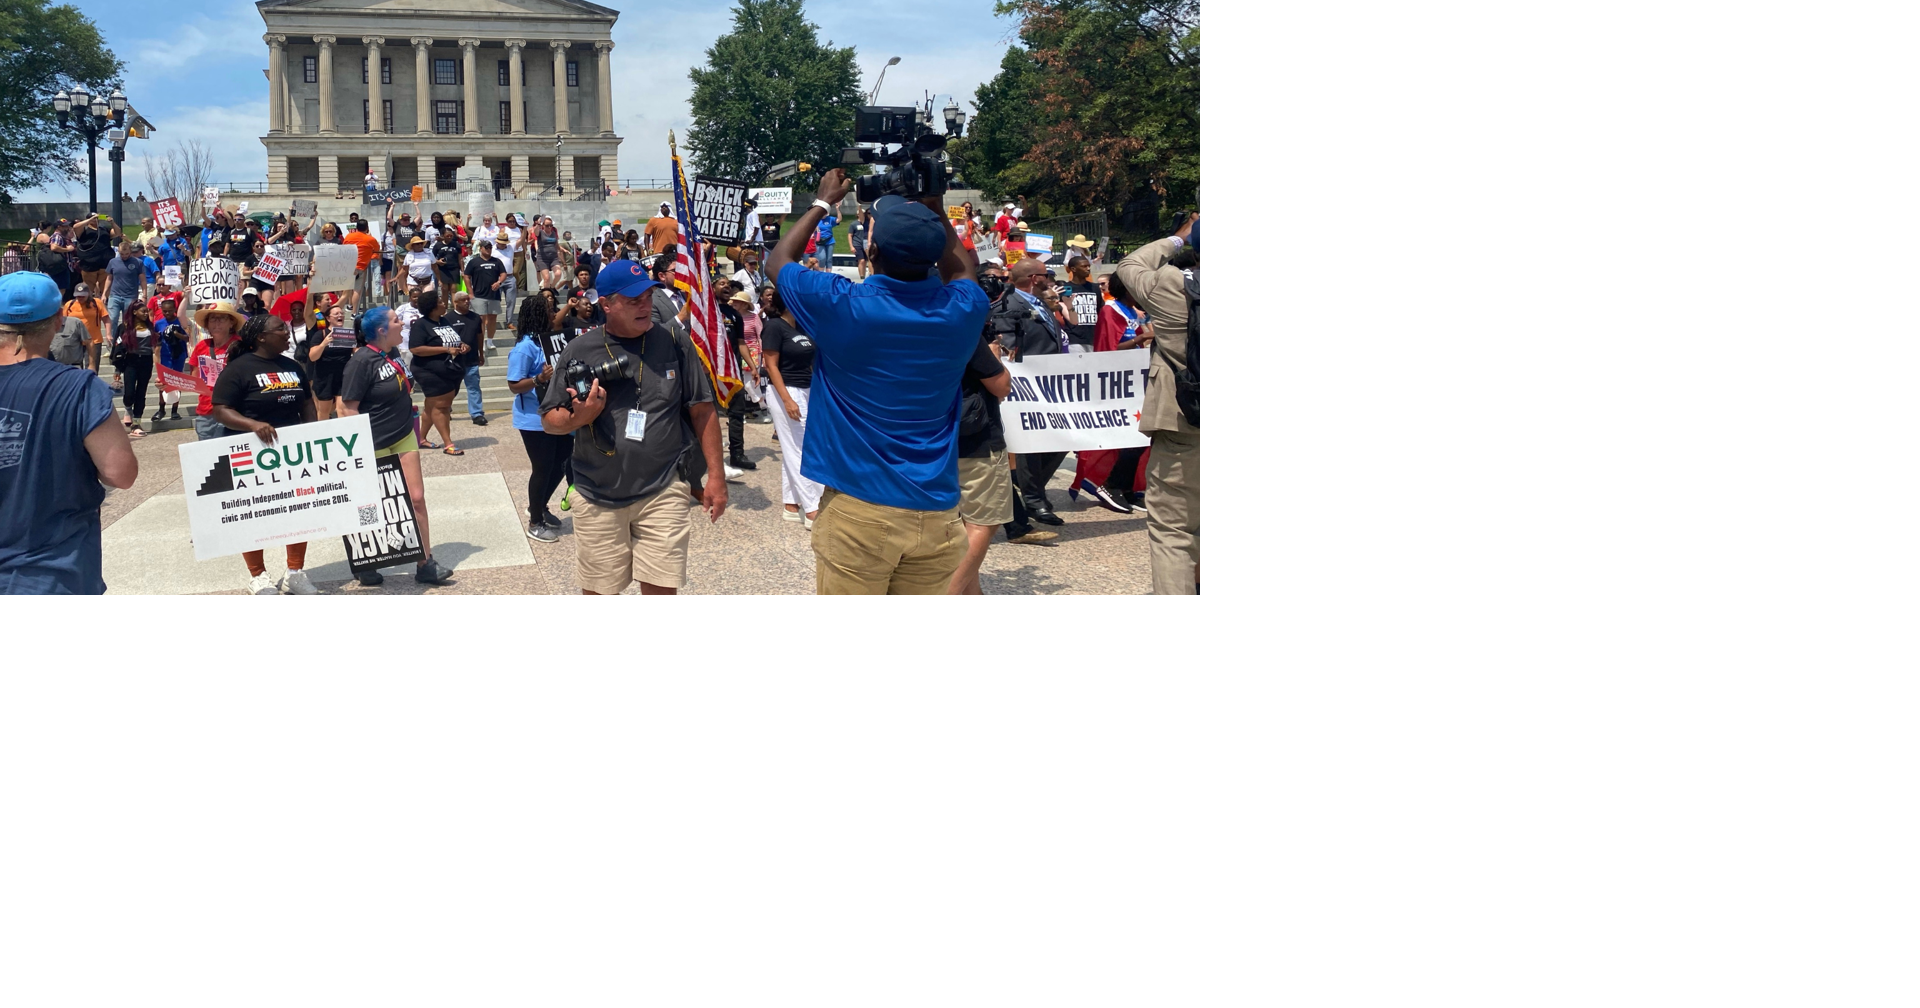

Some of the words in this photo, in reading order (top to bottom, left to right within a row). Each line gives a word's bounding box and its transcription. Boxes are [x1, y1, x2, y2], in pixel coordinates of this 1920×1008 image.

[390, 190, 412, 199] GUNS
[156, 205, 176, 215] ABOUT
[694, 201, 741, 222] VOTERS
[157, 211, 182, 229] US
[190, 258, 213, 273] FEAR
[260, 262, 270, 270] IT'S
[270, 265, 280, 274] THE
[263, 255, 283, 267] HINT-
[255, 268, 277, 282] GUNS
[194, 286, 237, 303] SCHOOL
[550, 333, 568, 352] IT'S
[255, 372, 300, 387] FREEDOM
[261, 381, 299, 392] SUMMER
[1035, 373, 1090, 403] WITH
[1098, 370, 1134, 400] THE
[1020, 412, 1047, 430] END
[1047, 412, 1071, 429] GUN
[1069, 409, 1130, 429] VIOLENCE
[230, 443, 250, 452] THE
[230, 433, 358, 476] EQUITY
[237, 458, 364, 489] ALLIANCE
[222, 497, 250, 509] Building
[252, 490, 295, 505] Independent
[296, 486, 315, 497] Black
[317, 481, 347, 494] political,
[222, 514, 238, 524] civic
[240, 511, 252, 520] and
[254, 505, 287, 518] economic
[289, 502, 310, 513] power
[312, 498, 331, 508] since
[332, 494, 351, 504] 2016.
